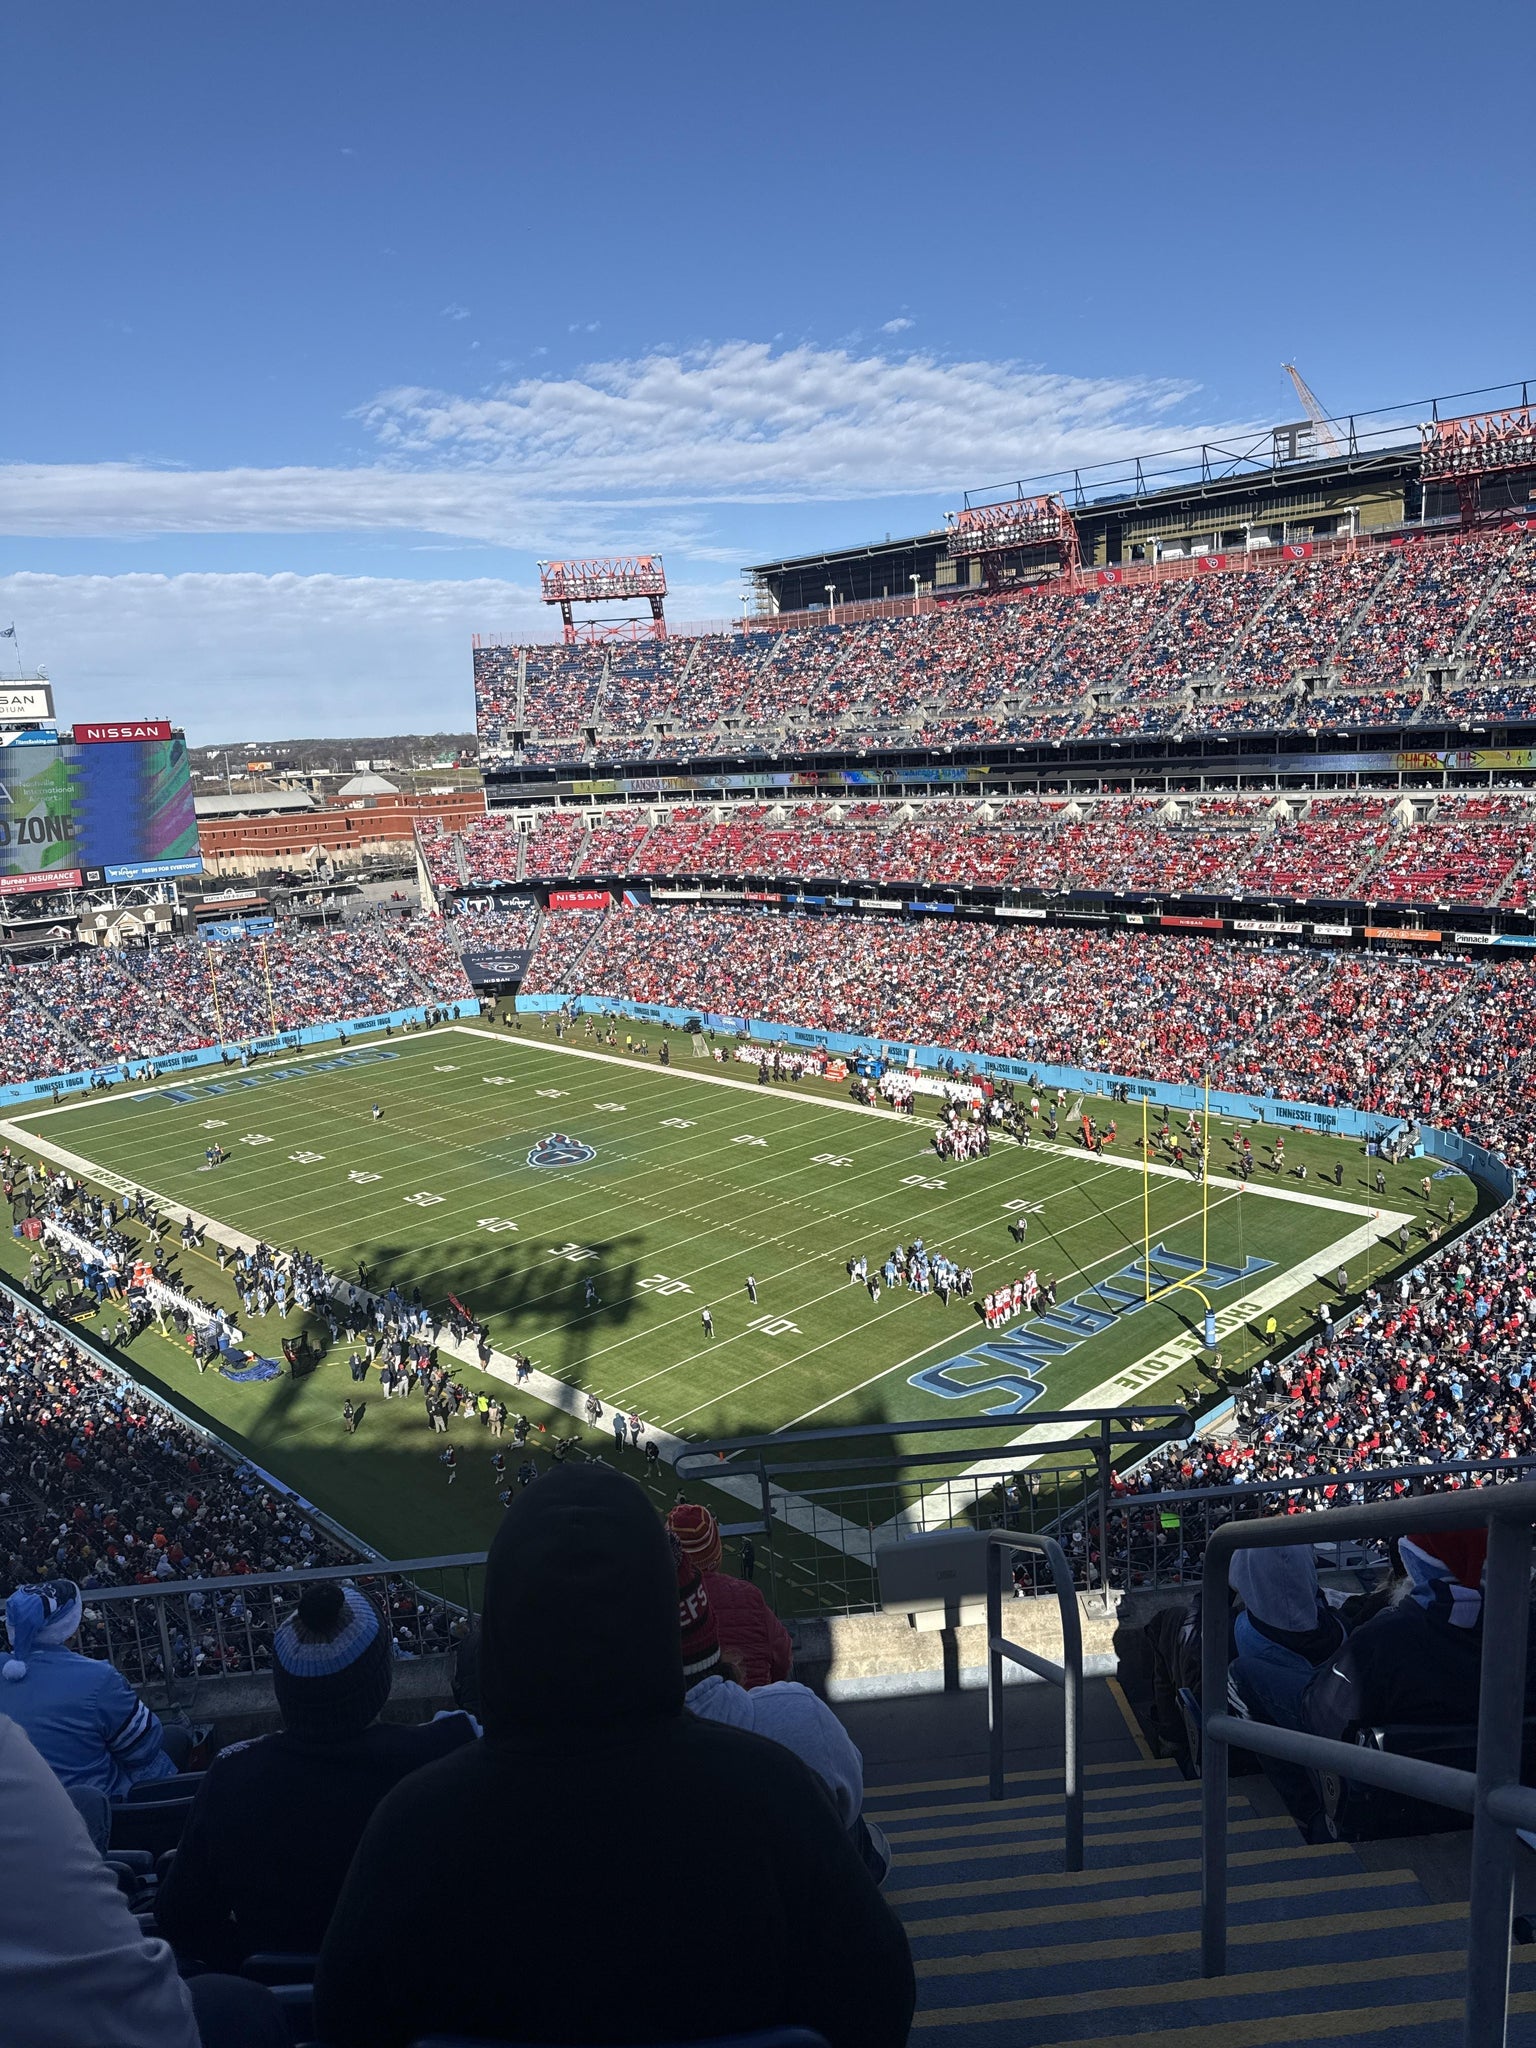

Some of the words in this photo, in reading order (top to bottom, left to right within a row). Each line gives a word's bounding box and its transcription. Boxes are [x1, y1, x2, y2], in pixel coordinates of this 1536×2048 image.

[87, 726, 159, 739] NISSAN
[23, 786, 75, 796] International
[630, 779, 661, 792] KANSAS
[14, 814, 74, 845] ZONE
[1, 877, 27, 886] Bureau
[28, 872, 75, 883] INSURANCE
[506, 897, 531, 908] Kroger
[556, 893, 602, 902] NISSAN
[1376, 930, 1399, 938] Tito's
[1456, 934, 1489, 944] Pinnacle
[471, 954, 522, 962] NISSAN
[152, 1057, 180, 1070] TENNESSEE
[181, 1054, 198, 1065] TOUGH
[985, 1061, 1011, 1074] TENNESSEE
[1011, 1064, 1028, 1076] TOUGH
[34, 1080, 64, 1093] TENNESSEE
[65, 1077, 84, 1088] TOUGH
[1275, 1106, 1312, 1122] TENNESSEE
[1313, 1112, 1337, 1126] TOUGH
[83, 1167, 133, 1190] INSPIRE
[402, 1191, 447, 1207] 50
[475, 1217, 518, 1233] 40
[547, 1242, 598, 1262] 30
[635, 1273, 692, 1296] 20
[746, 1313, 798, 1337] 10
[906, 1242, 1280, 1415] TITANS
[1112, 1350, 1184, 1391] LOVE
[680, 1584, 708, 1627] EFS
